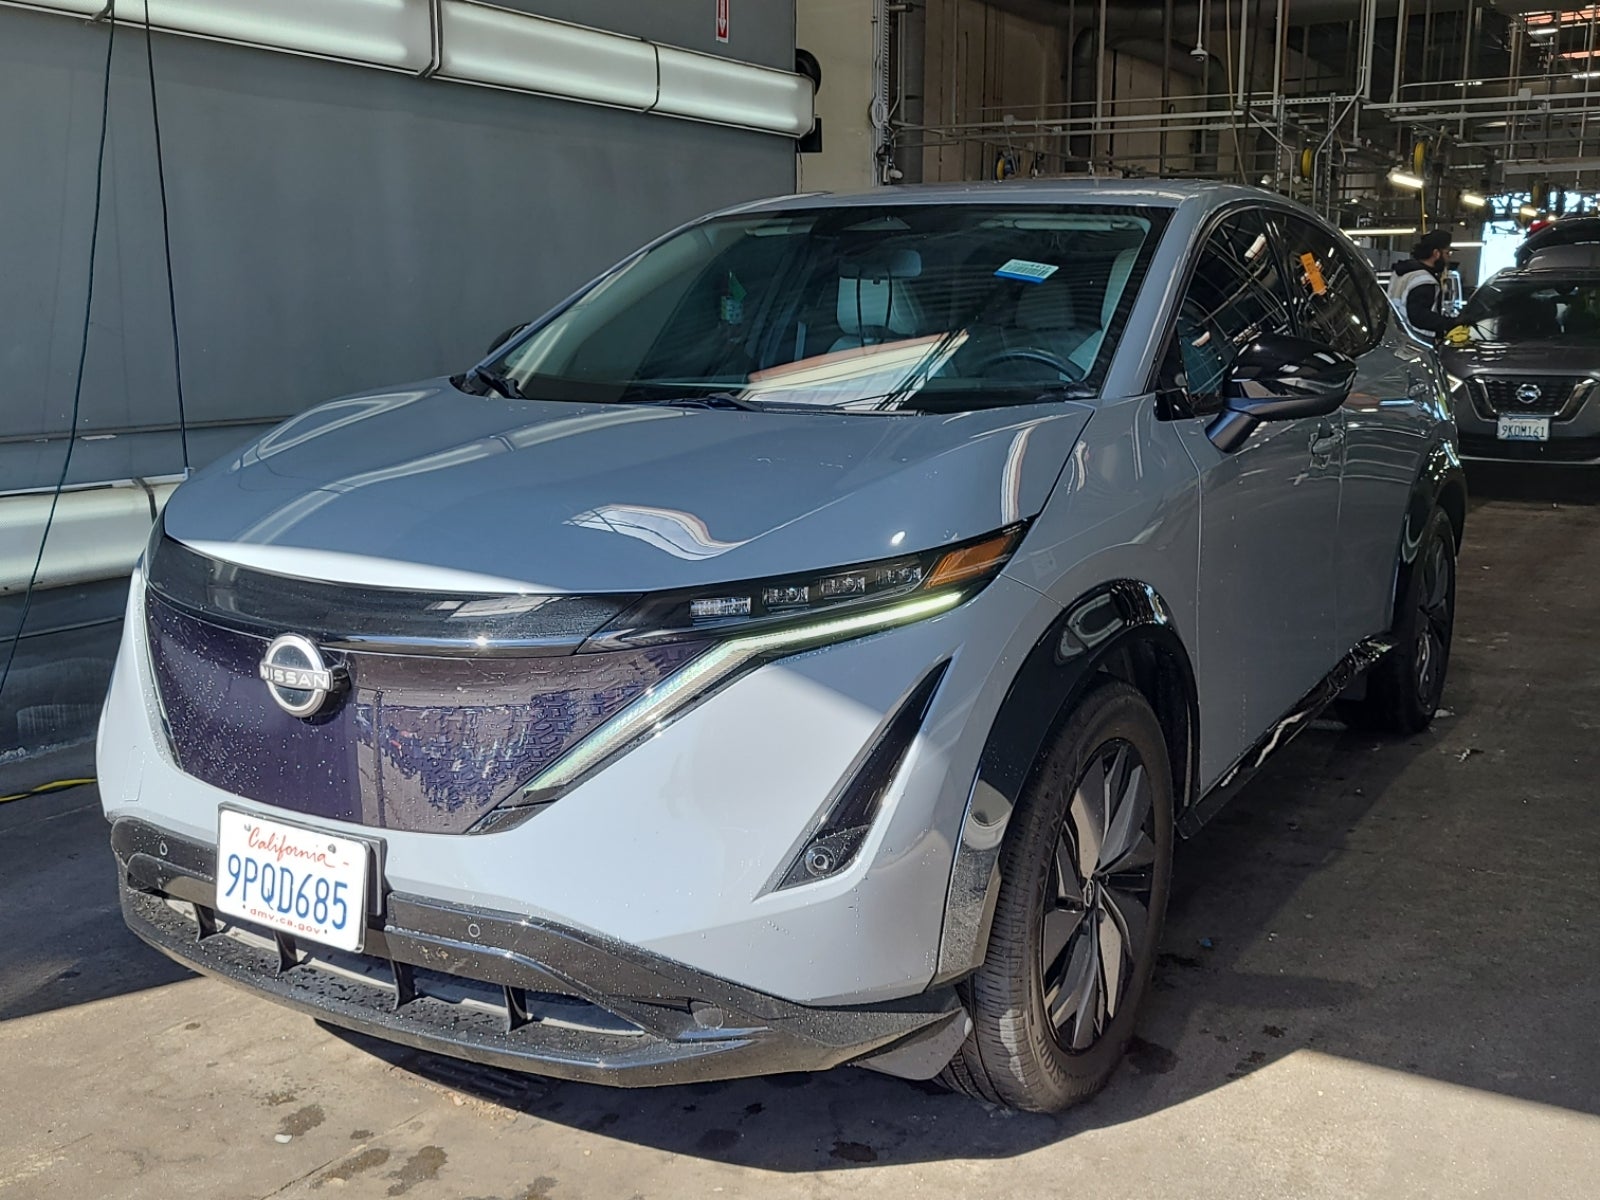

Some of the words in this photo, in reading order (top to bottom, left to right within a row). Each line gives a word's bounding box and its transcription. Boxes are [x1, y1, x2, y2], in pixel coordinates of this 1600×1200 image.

[260, 665, 329, 689] NISSAN
[248, 827, 335, 868] California
[225, 853, 348, 930] 9PQD685
[250, 908, 321, 934] dmv.ca.gov
